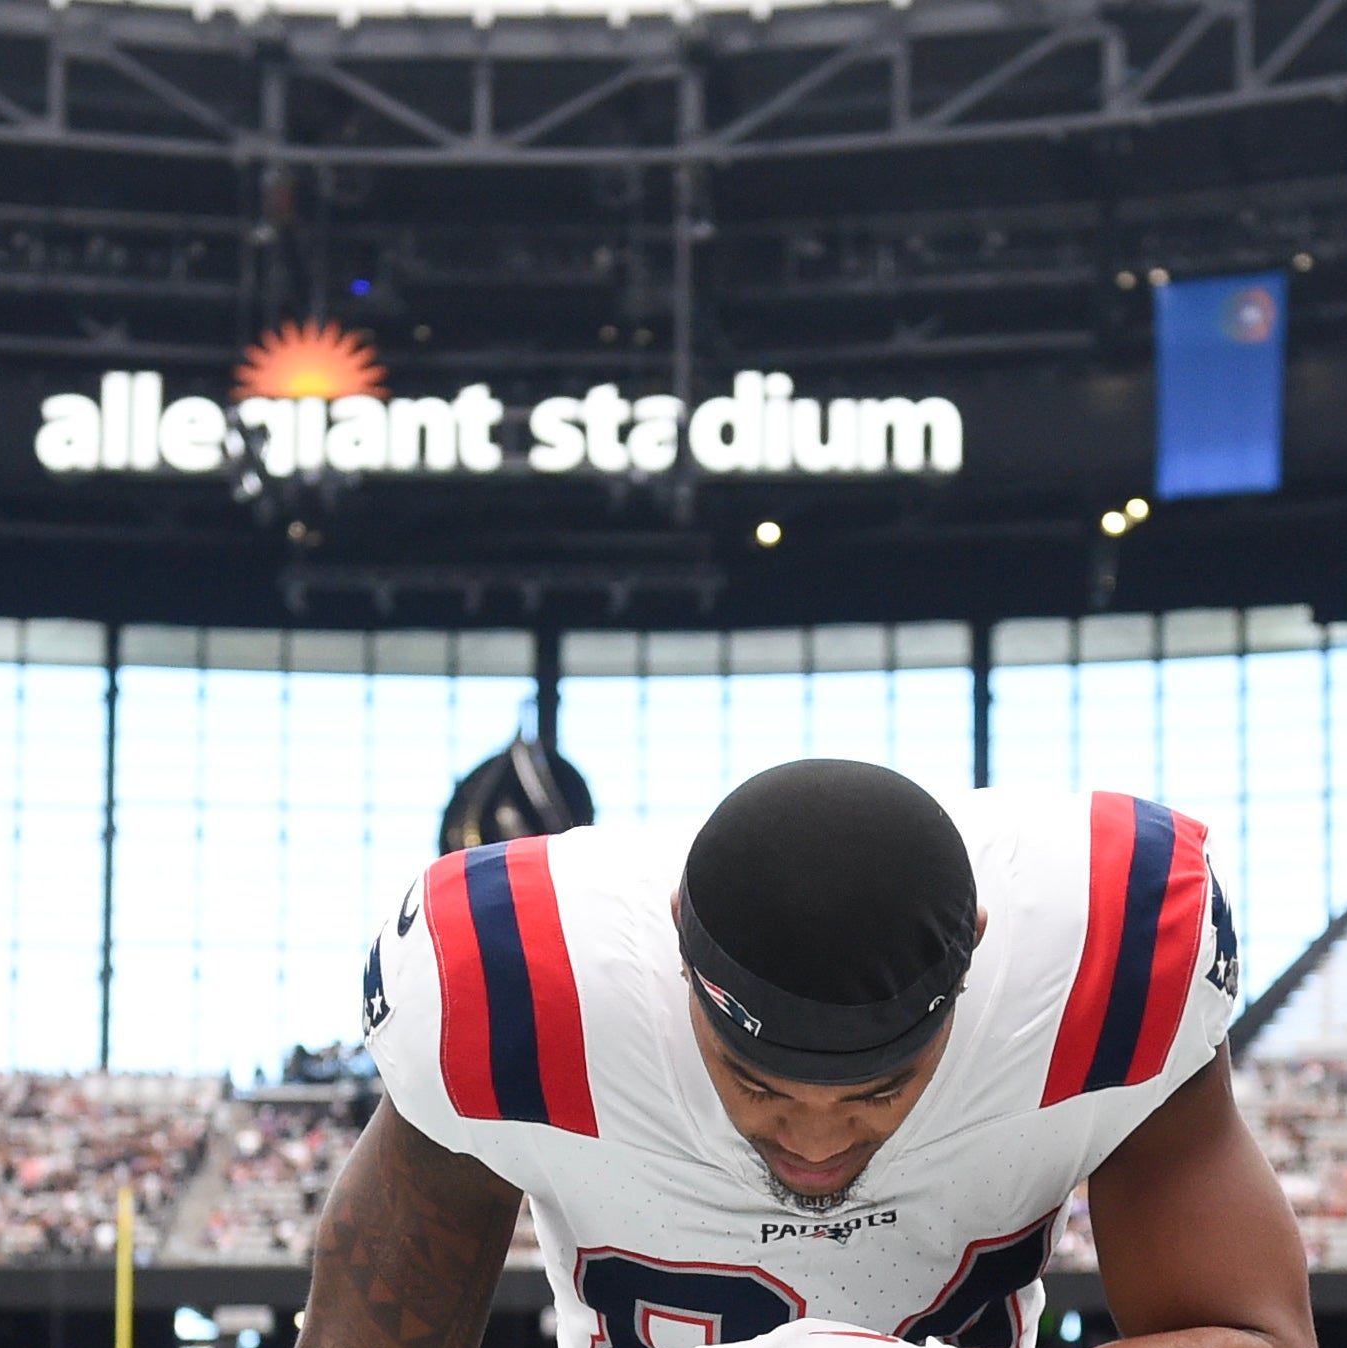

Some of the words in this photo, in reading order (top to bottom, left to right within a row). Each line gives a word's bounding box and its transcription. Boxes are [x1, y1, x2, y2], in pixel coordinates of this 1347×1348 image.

[35, 370, 504, 478] allegiant
[528, 370, 964, 473] stadium
[760, 1208, 899, 1246] PATRIOTS
